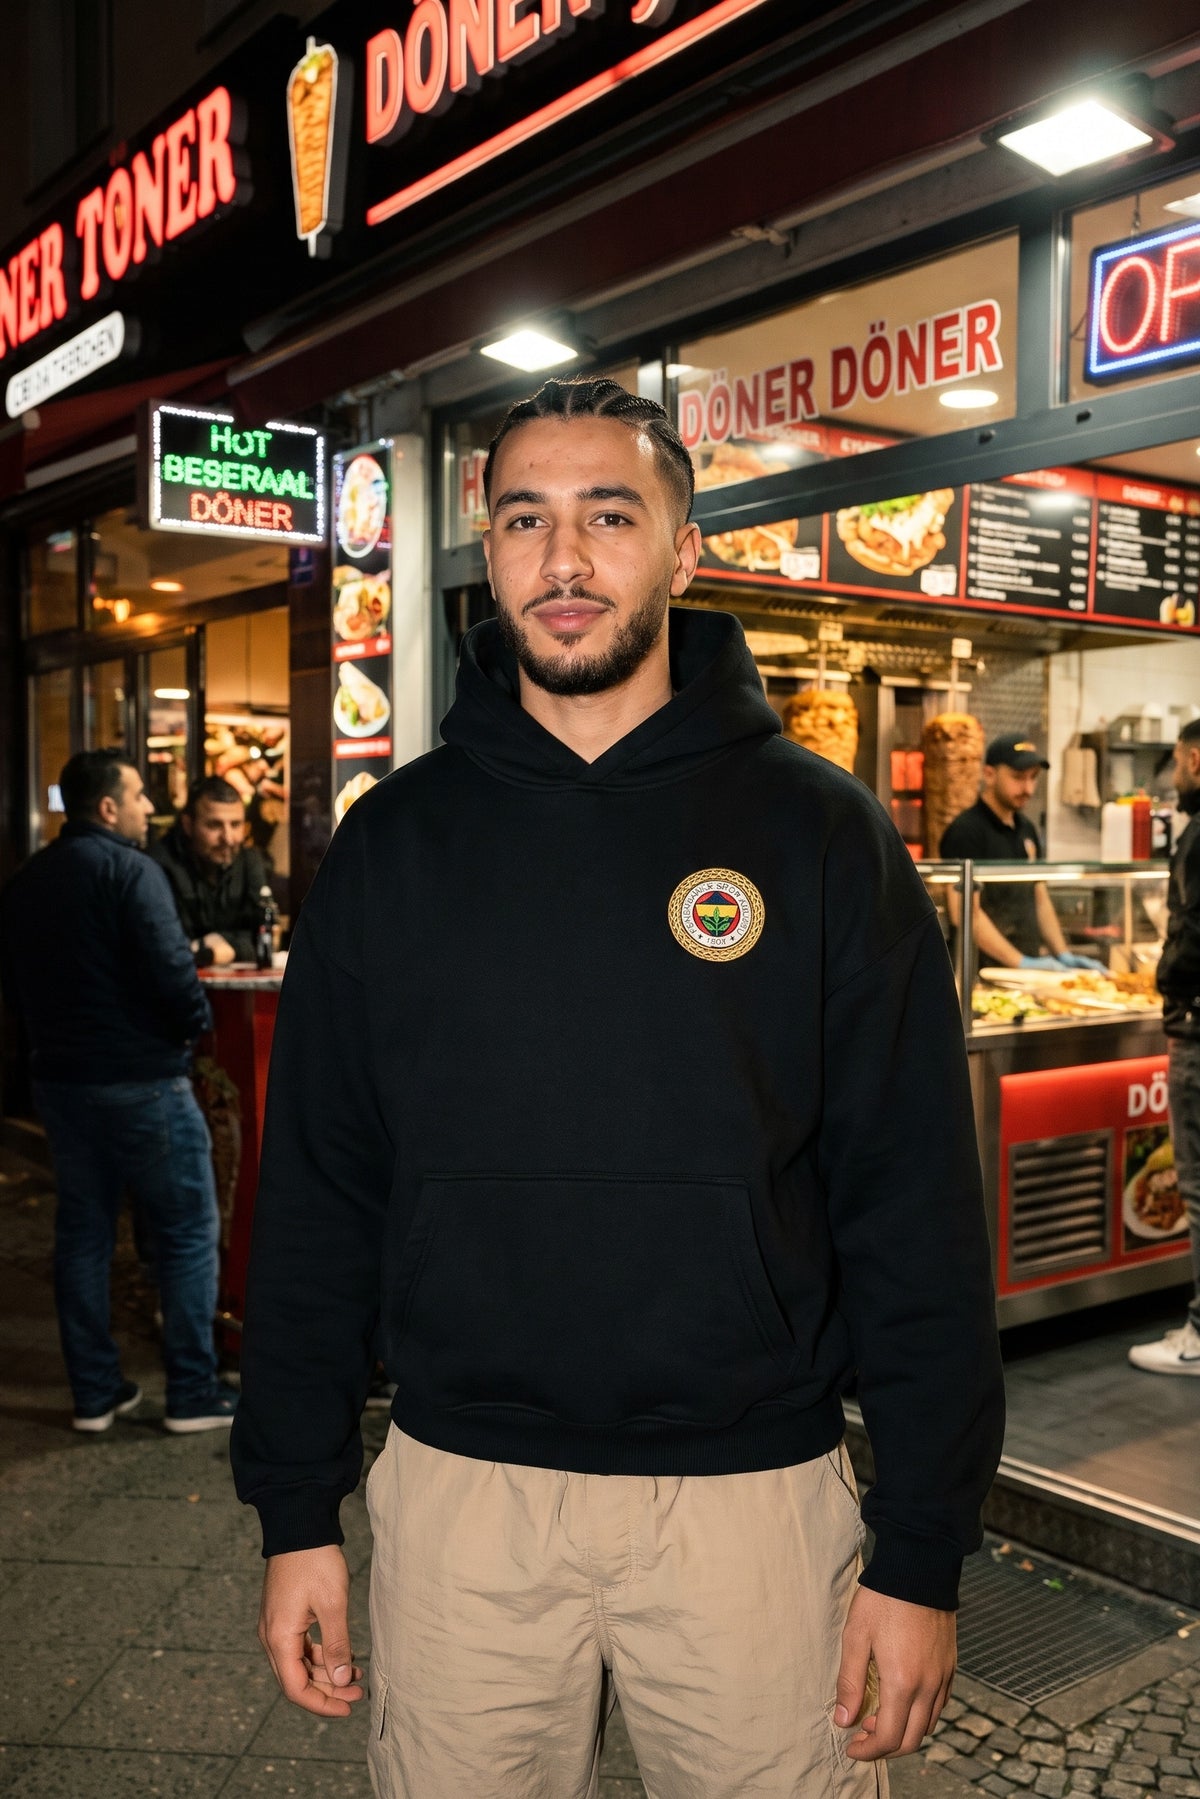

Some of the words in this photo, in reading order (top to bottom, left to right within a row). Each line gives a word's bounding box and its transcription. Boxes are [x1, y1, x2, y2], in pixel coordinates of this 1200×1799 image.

[680, 369, 818, 450] DÖNER
[830, 300, 1003, 412] DÖNER
[210, 424, 273, 458] HOT
[162, 454, 314, 500] BESERAAL
[190, 491, 293, 531] DÖNER
[1128, 1071, 1169, 1118] DÖ
